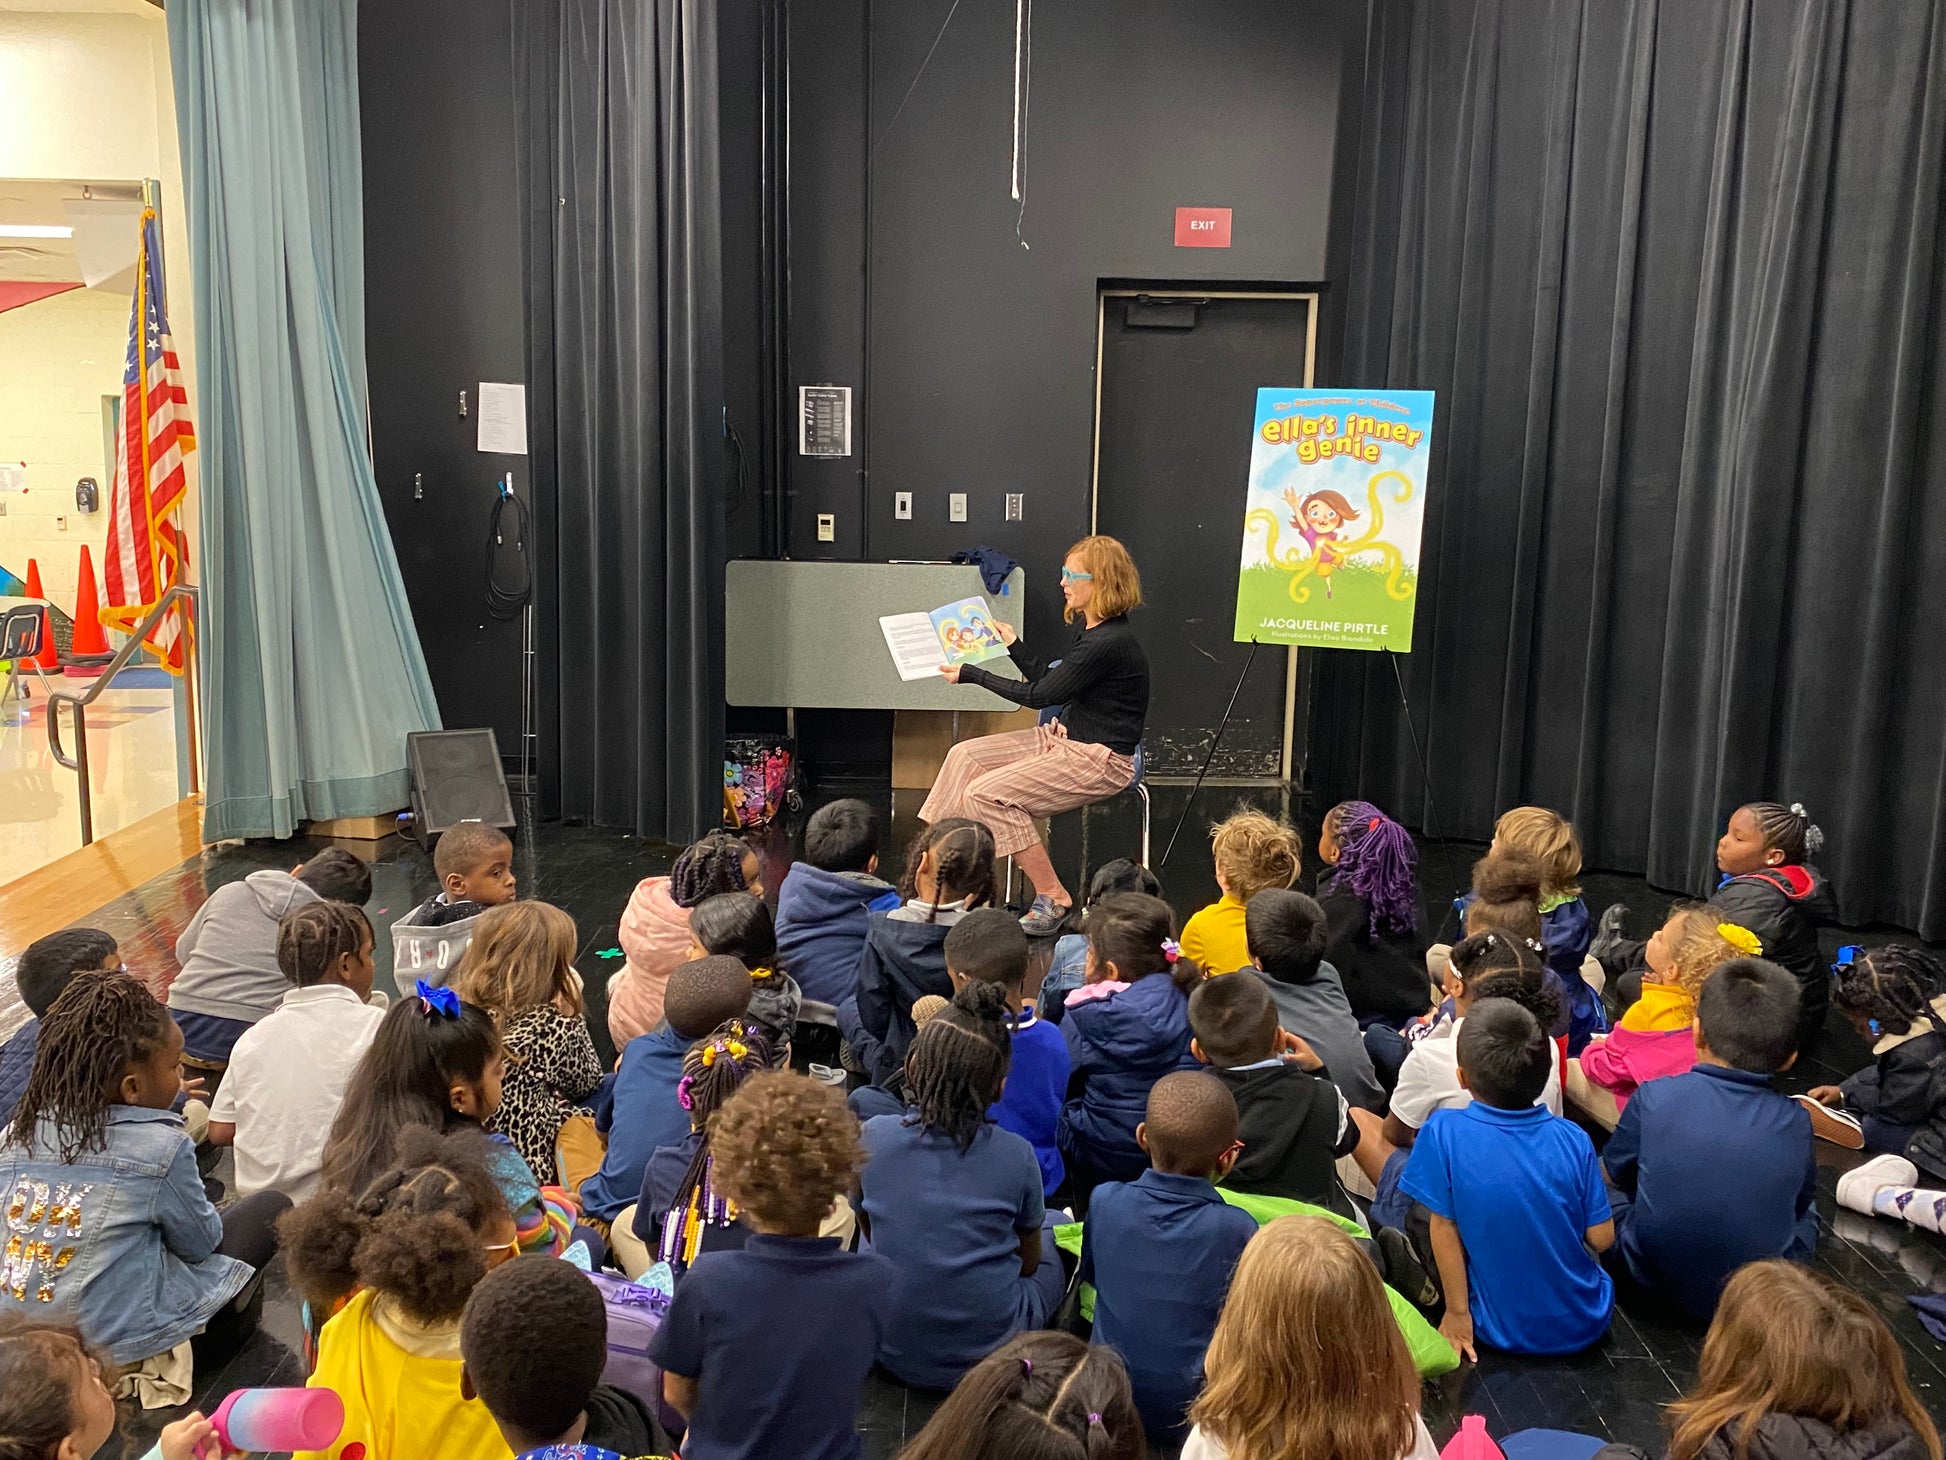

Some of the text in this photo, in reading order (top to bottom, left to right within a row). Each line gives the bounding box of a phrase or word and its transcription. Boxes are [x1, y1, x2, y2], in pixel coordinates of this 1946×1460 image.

[1191, 220, 1216, 230] EXIT
[1262, 414, 1422, 447] ella's inner
[1298, 436, 1380, 463] genie
[1259, 617, 1388, 635] JACQUELINE PIRTLE
[1271, 631, 1312, 640] Illustrations
[1313, 633, 1322, 641] by
